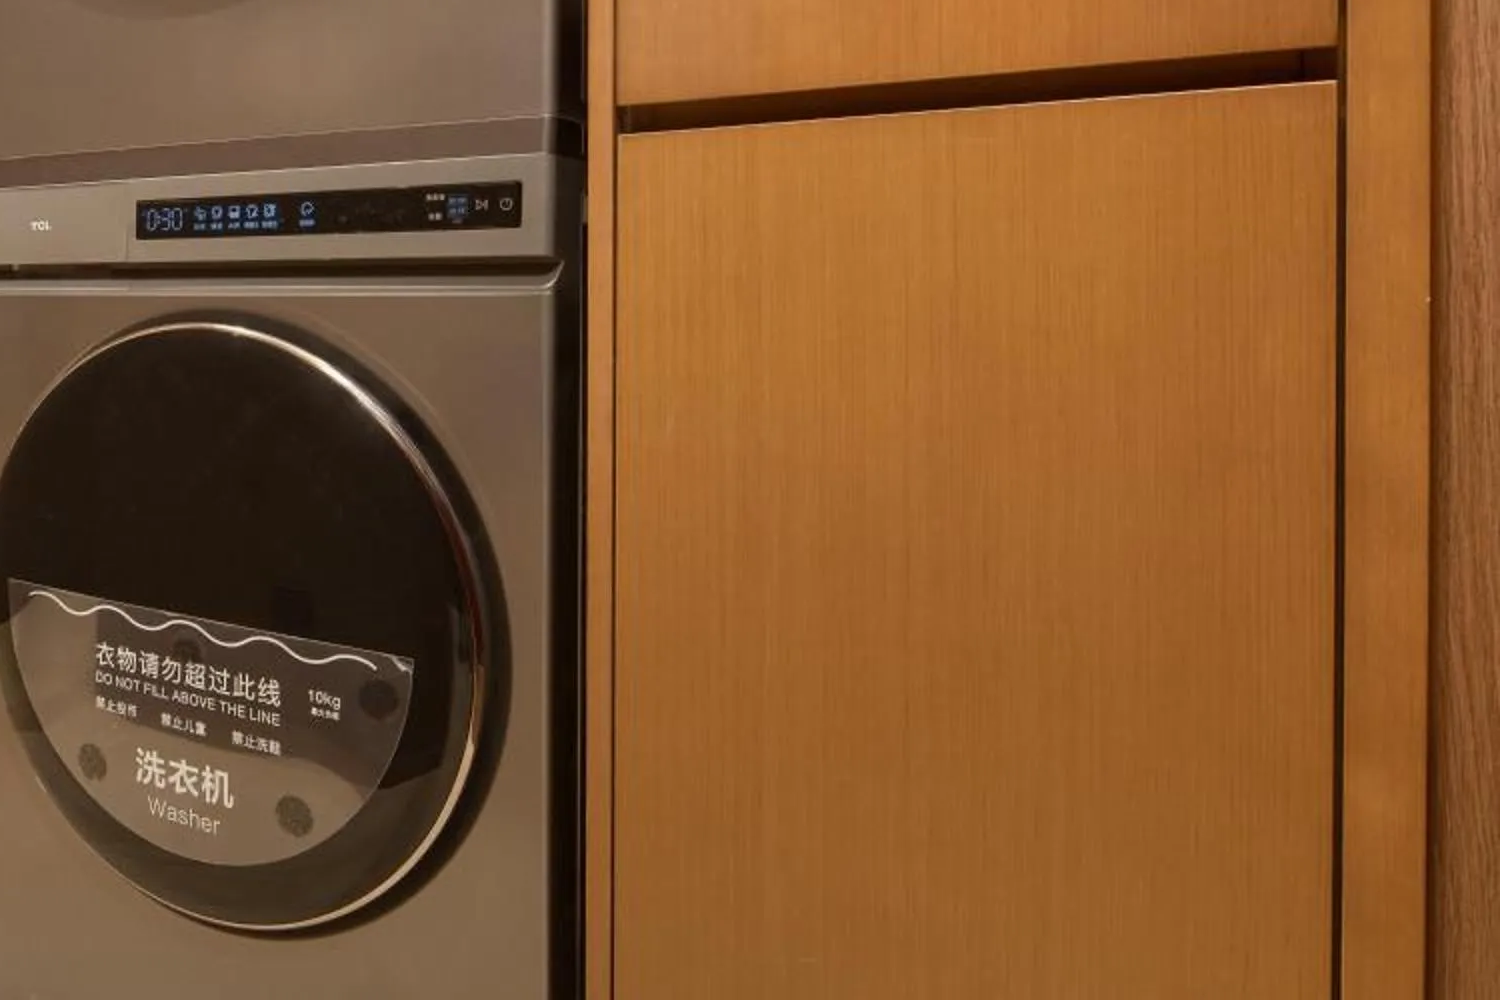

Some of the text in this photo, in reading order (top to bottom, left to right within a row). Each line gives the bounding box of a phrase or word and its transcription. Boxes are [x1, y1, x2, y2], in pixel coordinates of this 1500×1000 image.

[95, 642, 282, 707] 衣物请勿超过此线
[95, 671, 281, 727] DO NOT FILL ABOVE THE LINE
[308, 689, 341, 710] 10kg
[134, 746, 234, 809] 洗衣机
[147, 795, 221, 837] Washer
